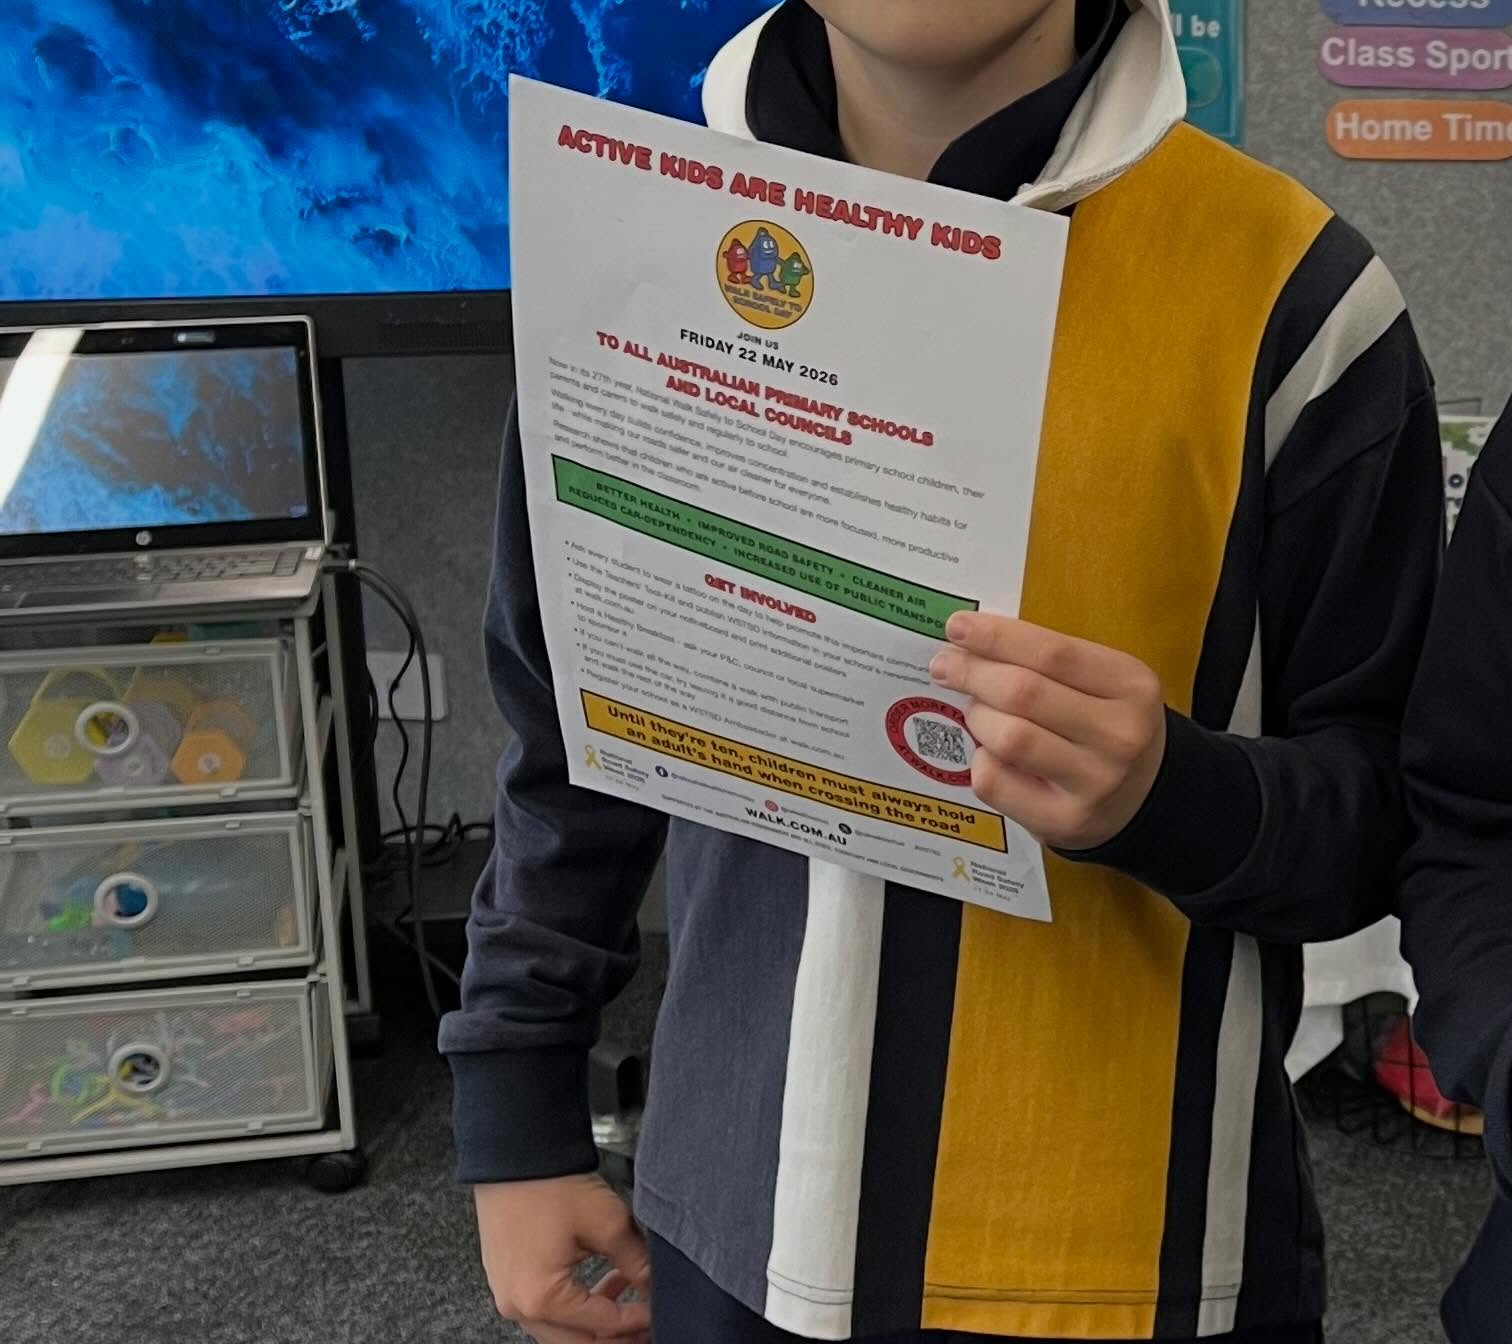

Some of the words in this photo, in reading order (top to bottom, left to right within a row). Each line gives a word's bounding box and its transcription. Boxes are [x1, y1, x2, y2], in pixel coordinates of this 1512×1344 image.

[1191, 14, 1221, 38] be
[1321, 37, 1415, 68] Class
[1335, 112, 1433, 142] Home
[558, 124, 652, 171] ACTIVE
[660, 152, 724, 190] KIDS
[730, 172, 787, 206] ARE
[794, 187, 924, 241] HEALTHY
[931, 222, 1001, 260] KIDS
[680, 329, 733, 355] FRIDAY
[738, 347, 757, 362] 22
[762, 354, 794, 373] MAY
[799, 365, 839, 386] 2026
[737, 332, 762, 346] JOIN
[765, 341, 779, 350] US
[597, 331, 619, 350] TO
[623, 341, 653, 363] ALL
[657, 352, 761, 397] AUSTRALIAN
[764, 385, 844, 421] PRIMARY
[847, 411, 934, 447] SCHOOLS
[666, 375, 700, 397] AND
[705, 388, 760, 418] LOCAL
[764, 407, 853, 446] COUNCILS
[845, 455, 881, 474] primary
[882, 465, 915, 483] school
[917, 475, 960, 495] children,
[962, 486, 985, 499] their
[568, 486, 617, 510] REDUCED
[620, 506, 716, 547] CAR-DEPENDENCY
[734, 547, 796, 577] INCREASED
[800, 572, 822, 586] USE
[825, 580, 840, 592] OF
[844, 587, 885, 609] PUBLIC
[888, 603, 945, 629] TRANSPO
[596, 482, 637, 503] BETTER
[640, 498, 680, 520] HEALTH
[698, 520, 755, 548] IMPROVED
[758, 542, 789, 559] ROAD
[793, 553, 833, 575] SAFETY
[852, 575, 904, 601] CLEANER
[906, 594, 926, 608] AIR
[705, 574, 736, 595] GET
[740, 586, 817, 624] INVOLVED
[608, 705, 646, 728] Until
[650, 719, 706, 748] they're
[710, 739, 743, 761] ten,
[749, 752, 817, 783] children
[821, 776, 865, 797] must
[872, 785, 932, 814] always
[937, 805, 975, 825] hold
[626, 726, 646, 742] an
[651, 735, 707, 762] adult's
[711, 753, 753, 776] hand
[758, 768, 803, 792] when
[808, 784, 881, 816] crossing
[885, 803, 915, 823] the
[920, 814, 961, 835] road
[745, 806, 848, 846] WALK.COM.AU
